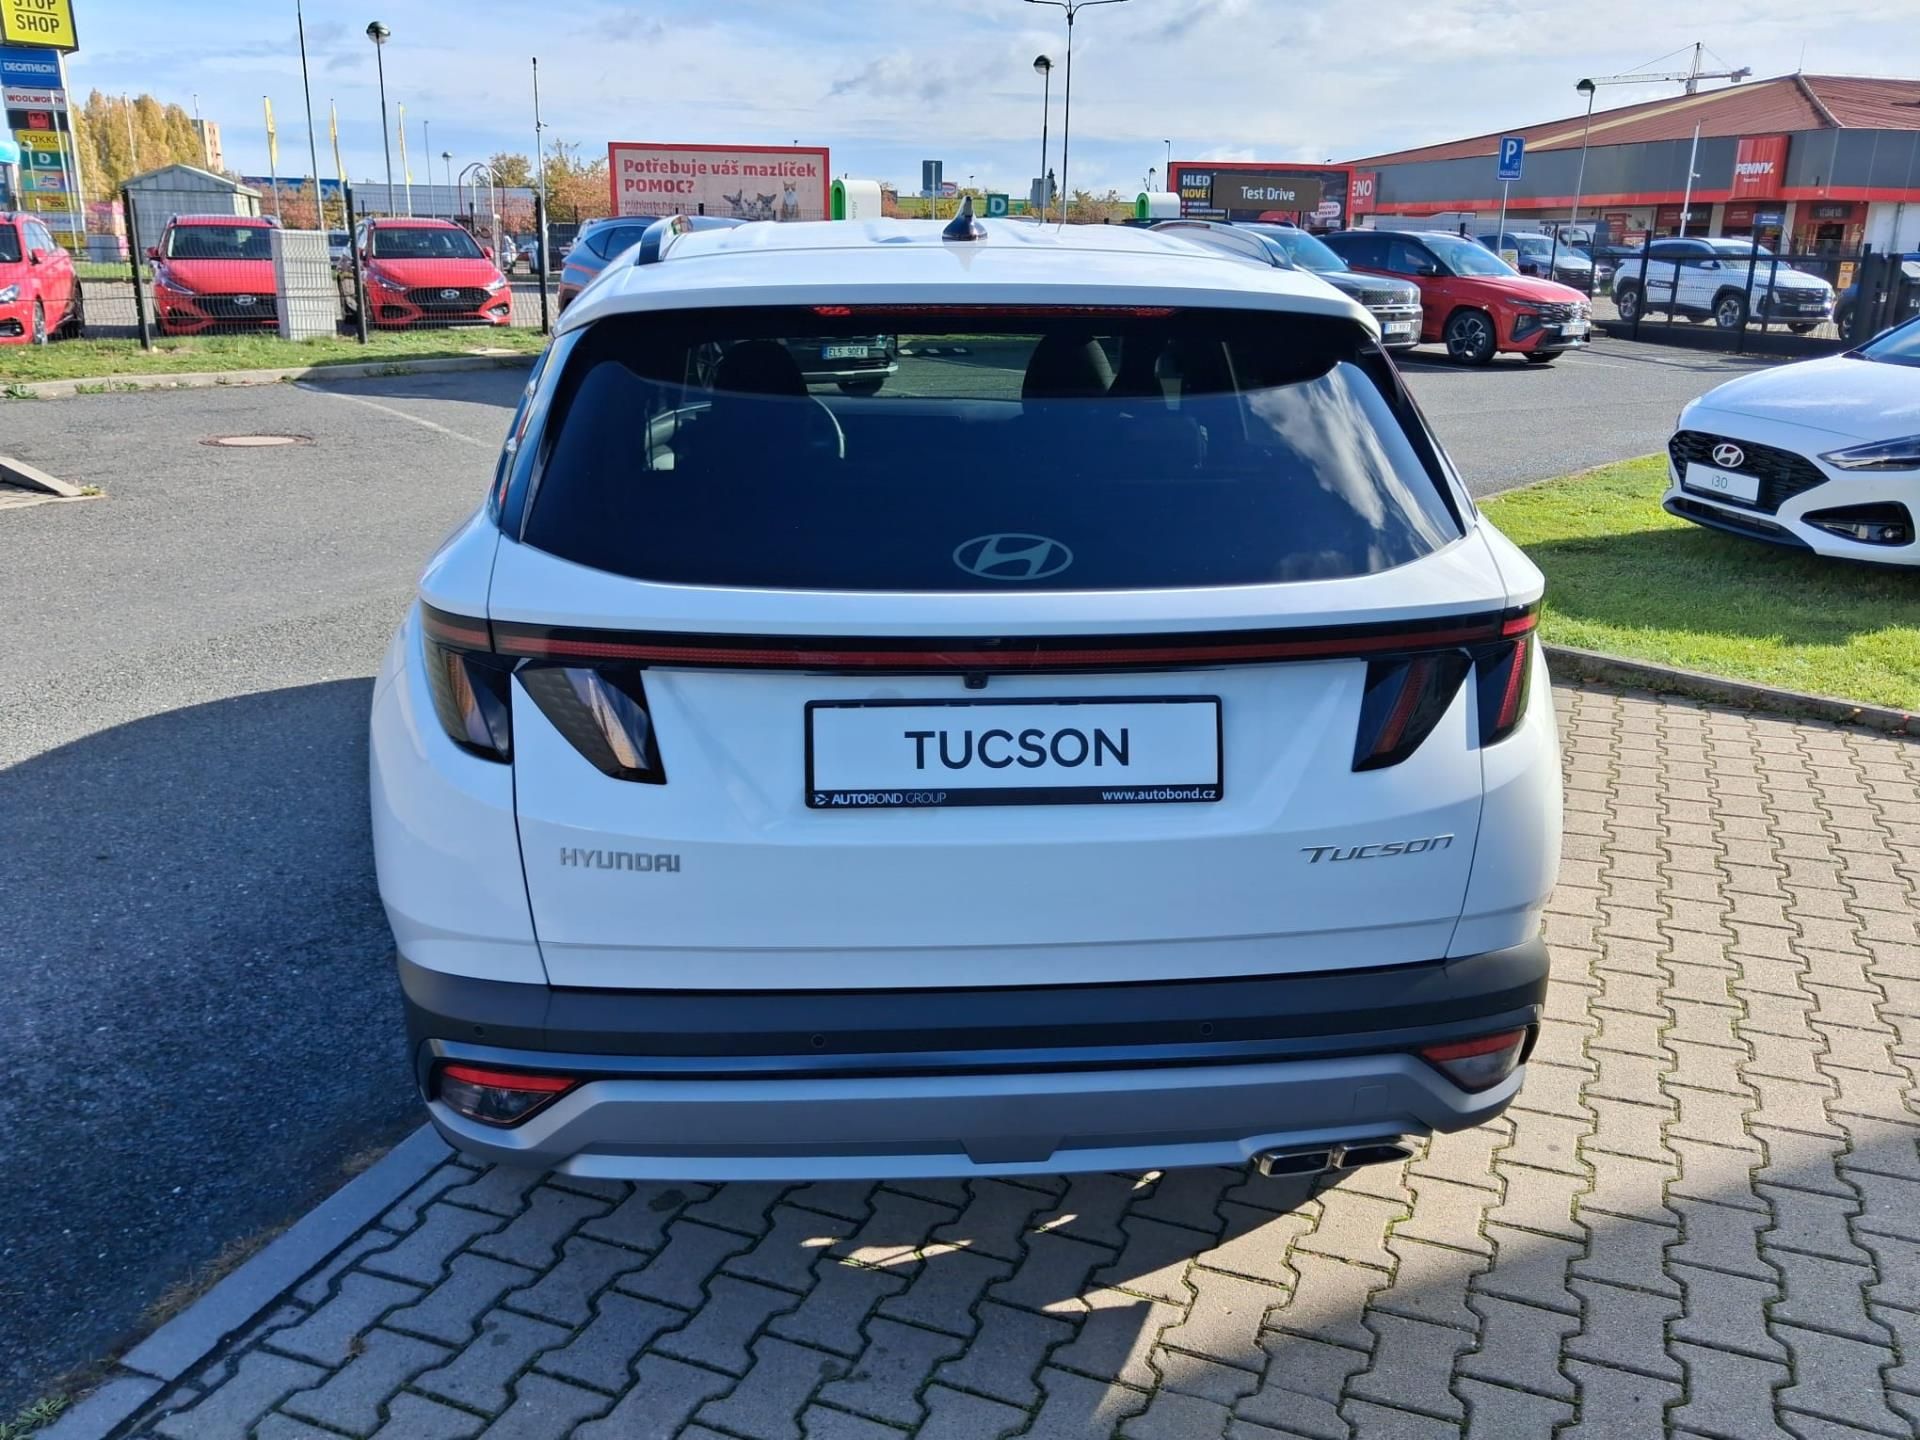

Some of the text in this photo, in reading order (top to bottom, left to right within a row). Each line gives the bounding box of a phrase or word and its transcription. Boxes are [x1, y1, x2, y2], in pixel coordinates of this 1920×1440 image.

[16, 14, 60, 34] SHOP
[2, 62, 56, 73] DECATHLON
[1505, 140, 1518, 164] P
[624, 158, 817, 178] Potřebuje váš mazlíček
[624, 178, 694, 194] POMOC?
[1181, 187, 1207, 199] NOVÉ
[1240, 186, 1295, 201] Test Drive
[1711, 474, 1728, 489] i30
[904, 727, 1130, 770] TUCSON
[831, 791, 947, 805] AUTOBOND GROUP
[1102, 787, 1216, 802] www.autobond.cz
[560, 846, 680, 873] HYUNDAI
